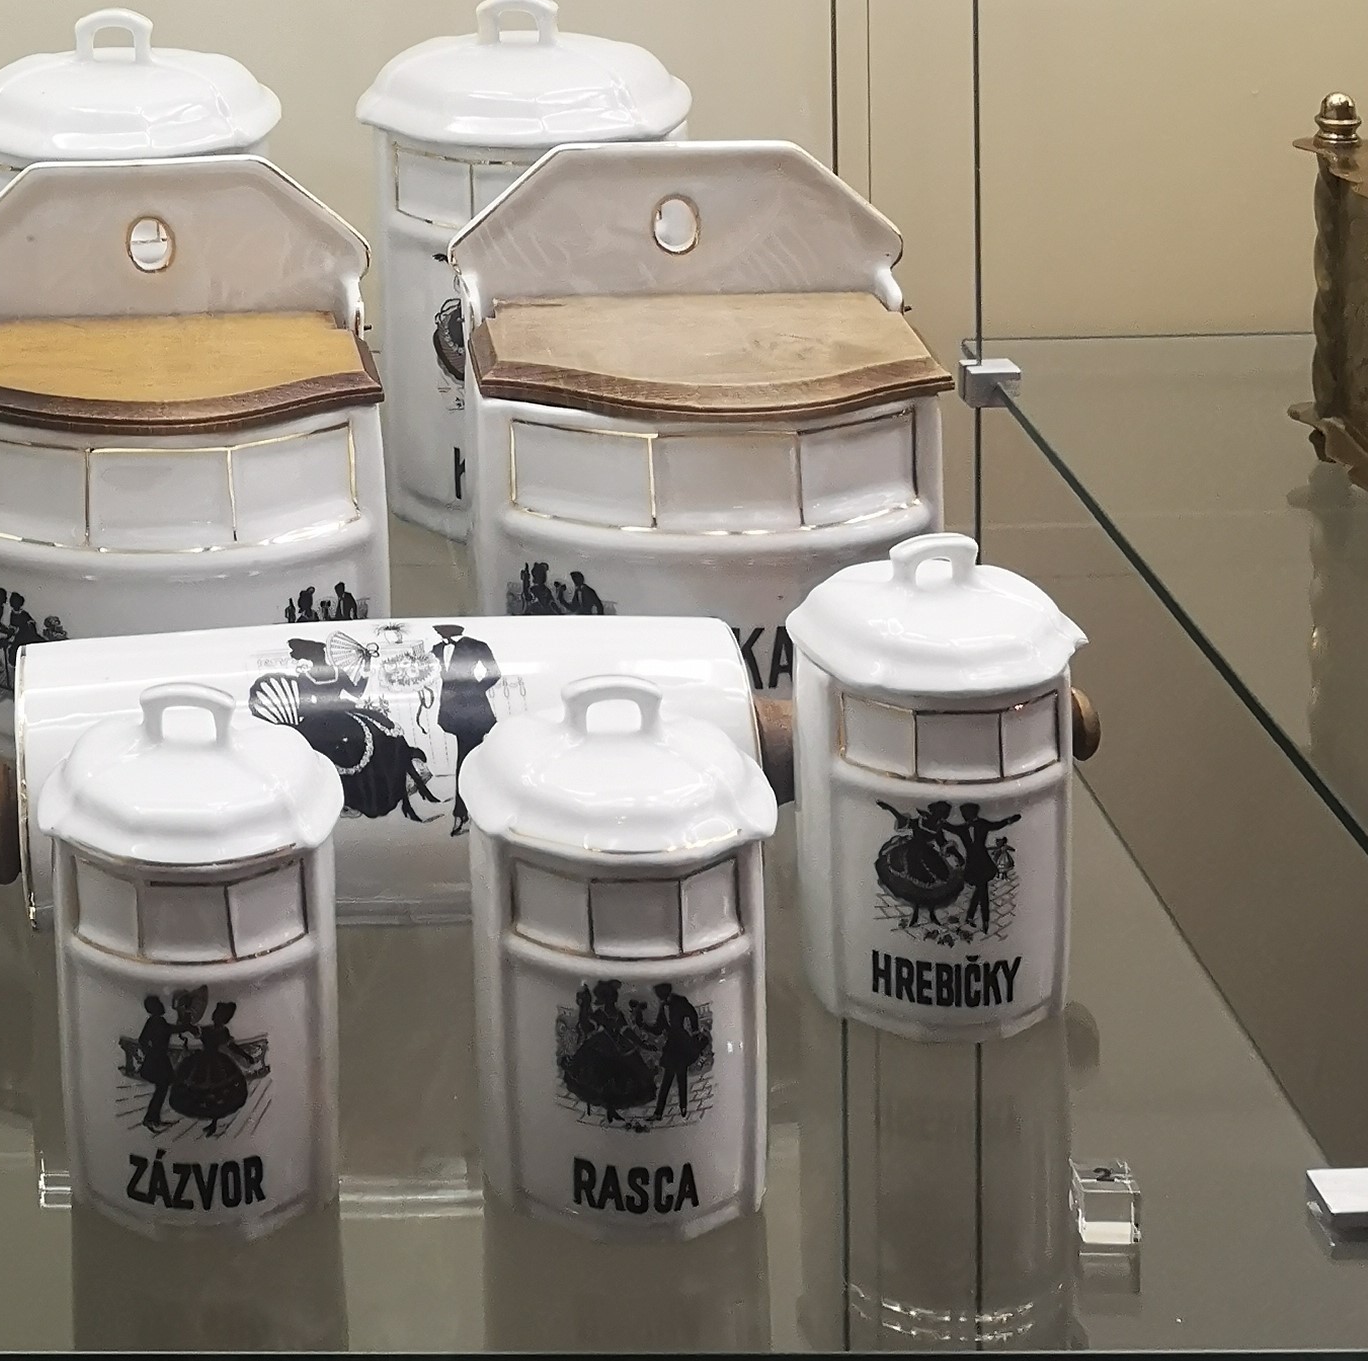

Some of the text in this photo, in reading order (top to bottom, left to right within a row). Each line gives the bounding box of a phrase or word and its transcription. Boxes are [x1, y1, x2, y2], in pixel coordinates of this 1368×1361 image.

[871, 954, 1023, 1008] HREBIČKY
[126, 1149, 267, 1211] ZÁZVOR
[572, 1157, 700, 1216] RASCA
